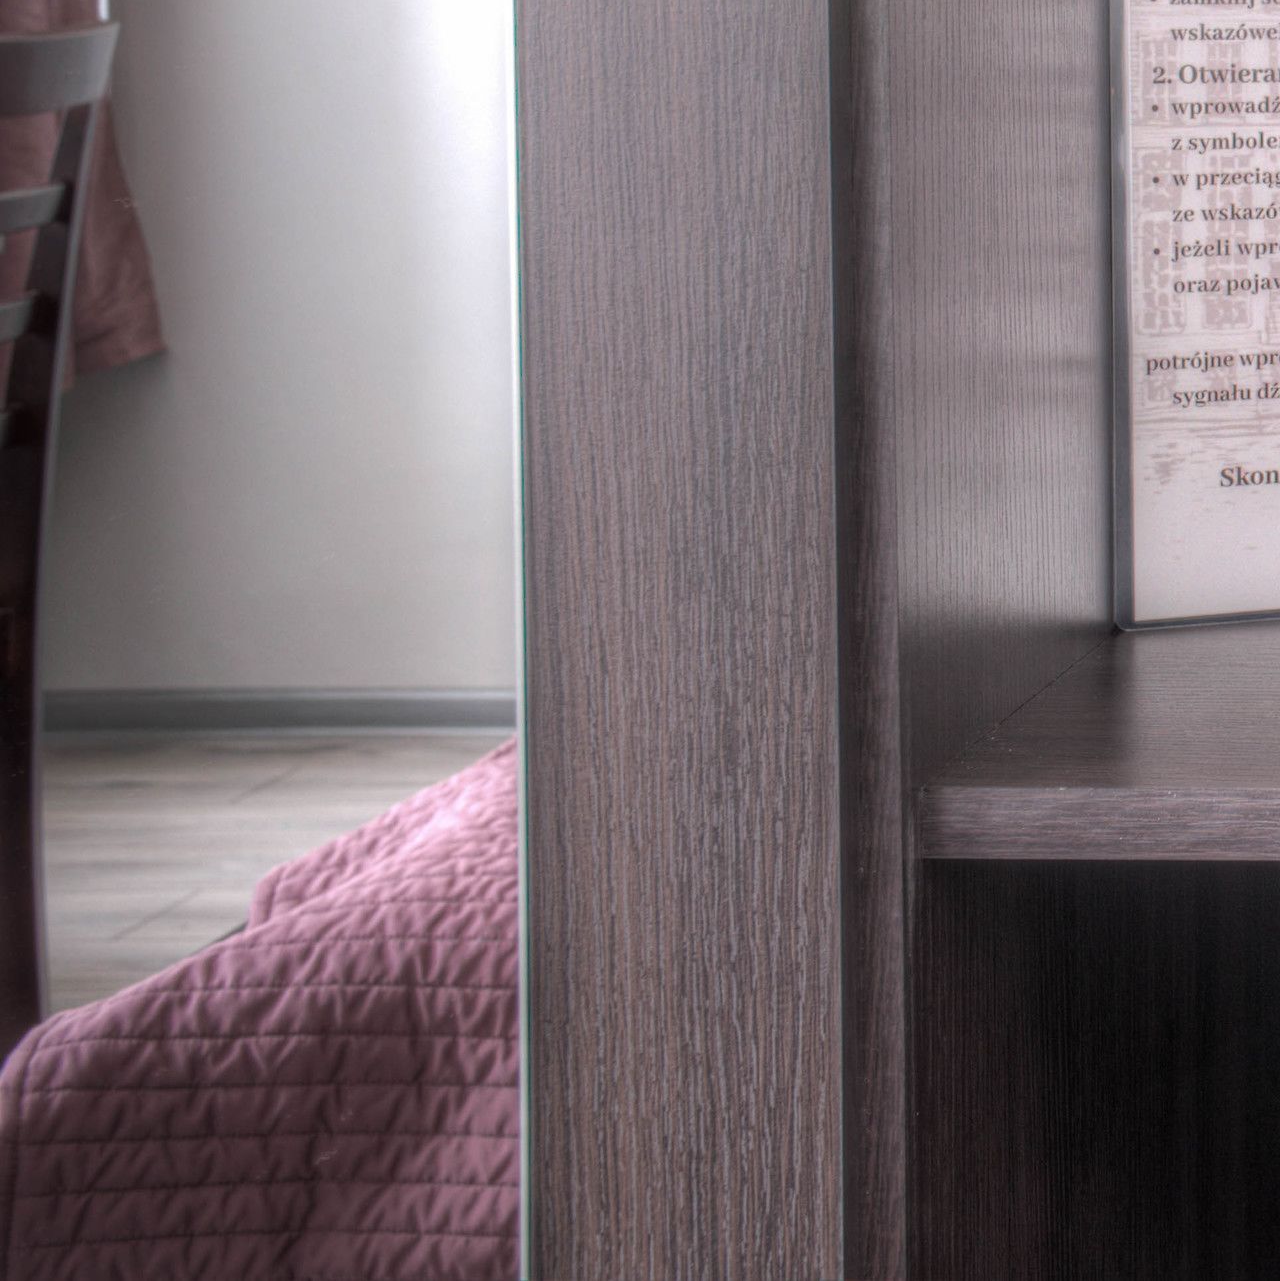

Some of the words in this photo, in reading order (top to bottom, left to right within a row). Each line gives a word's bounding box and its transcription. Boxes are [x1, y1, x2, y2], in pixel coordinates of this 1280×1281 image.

[1153, 66, 1172, 84] 2.
[1171, 97, 1280, 118] wprowadź
[1172, 138, 1182, 150] z
[1173, 173, 1189, 186] w
[1172, 209, 1194, 222] ze
[1172, 240, 1230, 261] jeżeli
[1174, 278, 1220, 294] oraz
[1146, 351, 1235, 375] potrójne
[1173, 384, 1250, 407] sygnału
